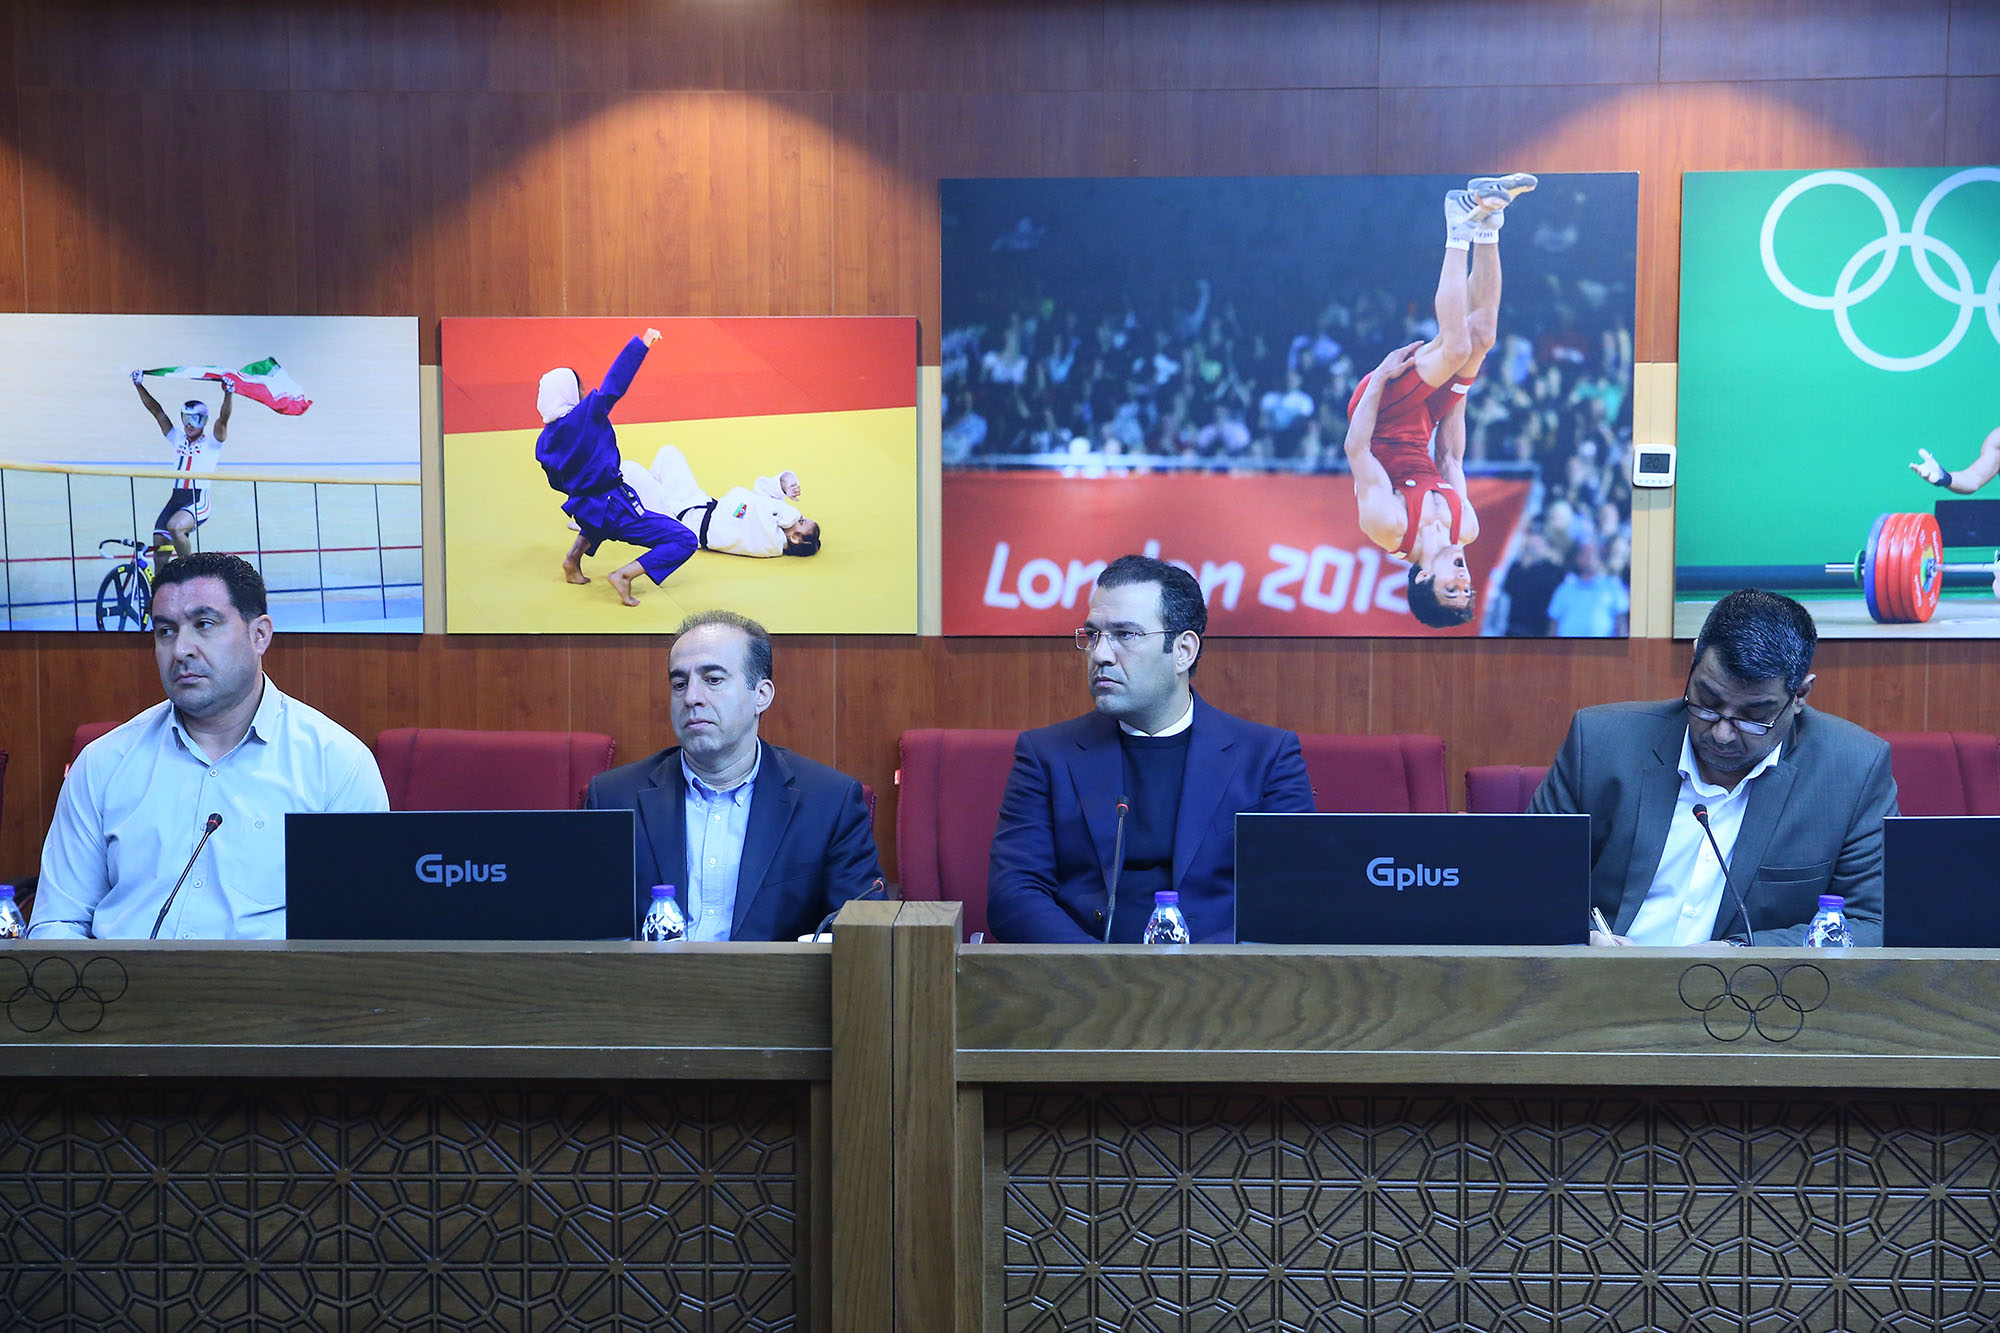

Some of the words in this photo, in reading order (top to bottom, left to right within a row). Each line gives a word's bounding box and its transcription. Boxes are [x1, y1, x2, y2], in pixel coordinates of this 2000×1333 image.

[984, 538, 1245, 610] Lonn
[415, 853, 507, 888] Gplus
[1366, 856, 1460, 891] Gplus
